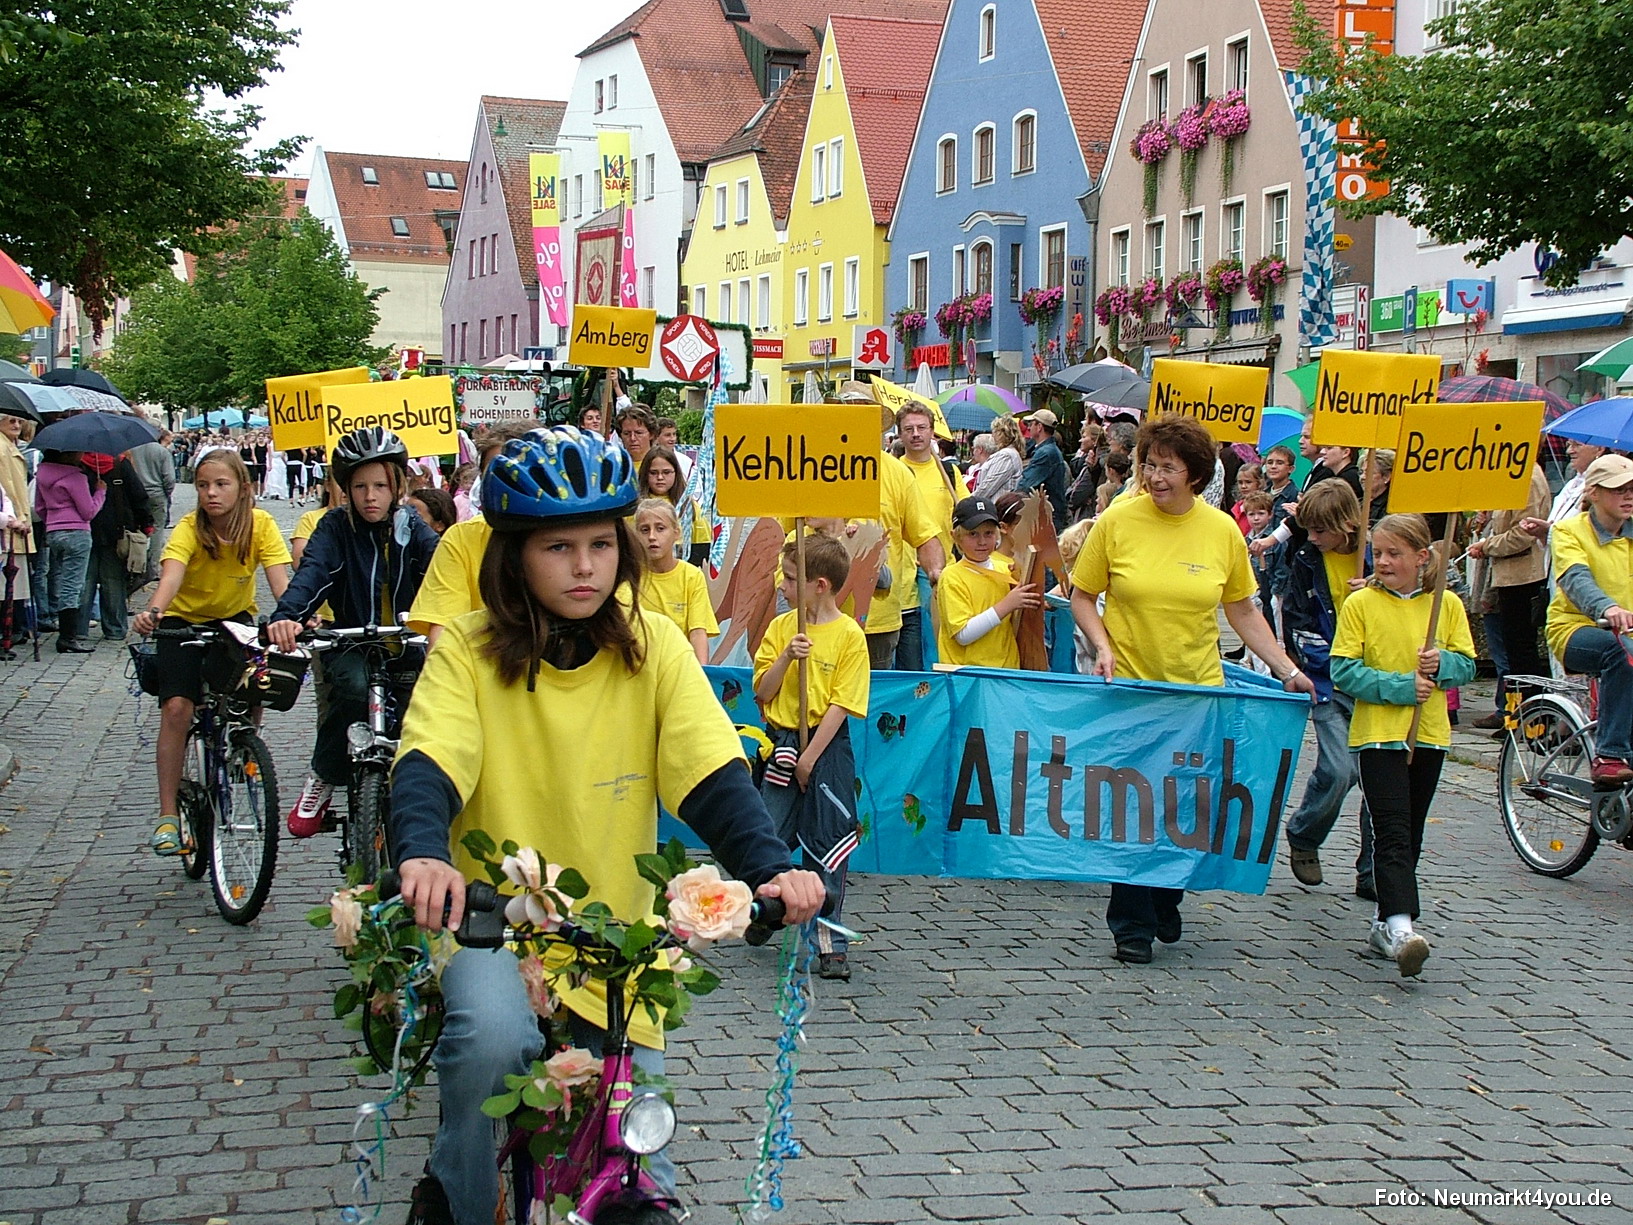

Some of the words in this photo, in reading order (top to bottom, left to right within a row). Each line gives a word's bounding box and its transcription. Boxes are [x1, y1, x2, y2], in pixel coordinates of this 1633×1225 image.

[725, 250, 749, 273] HOTEL
[754, 246, 782, 266] Lehmeier
[575, 320, 649, 353] Amberg
[698, 322, 714, 341] VEREIN
[1357, 287, 1367, 350] KINO
[698, 360, 712, 375] BERG
[469, 406, 530, 419] HÖHENBERG
[1155, 382, 1255, 432] Nürnberg
[1319, 368, 1436, 417] Neumarkt
[327, 400, 453, 436] Regensburg
[722, 434, 877, 483] Kehlheim
[1403, 424, 1530, 479] Berching
[947, 727, 1293, 864] Altmühl
